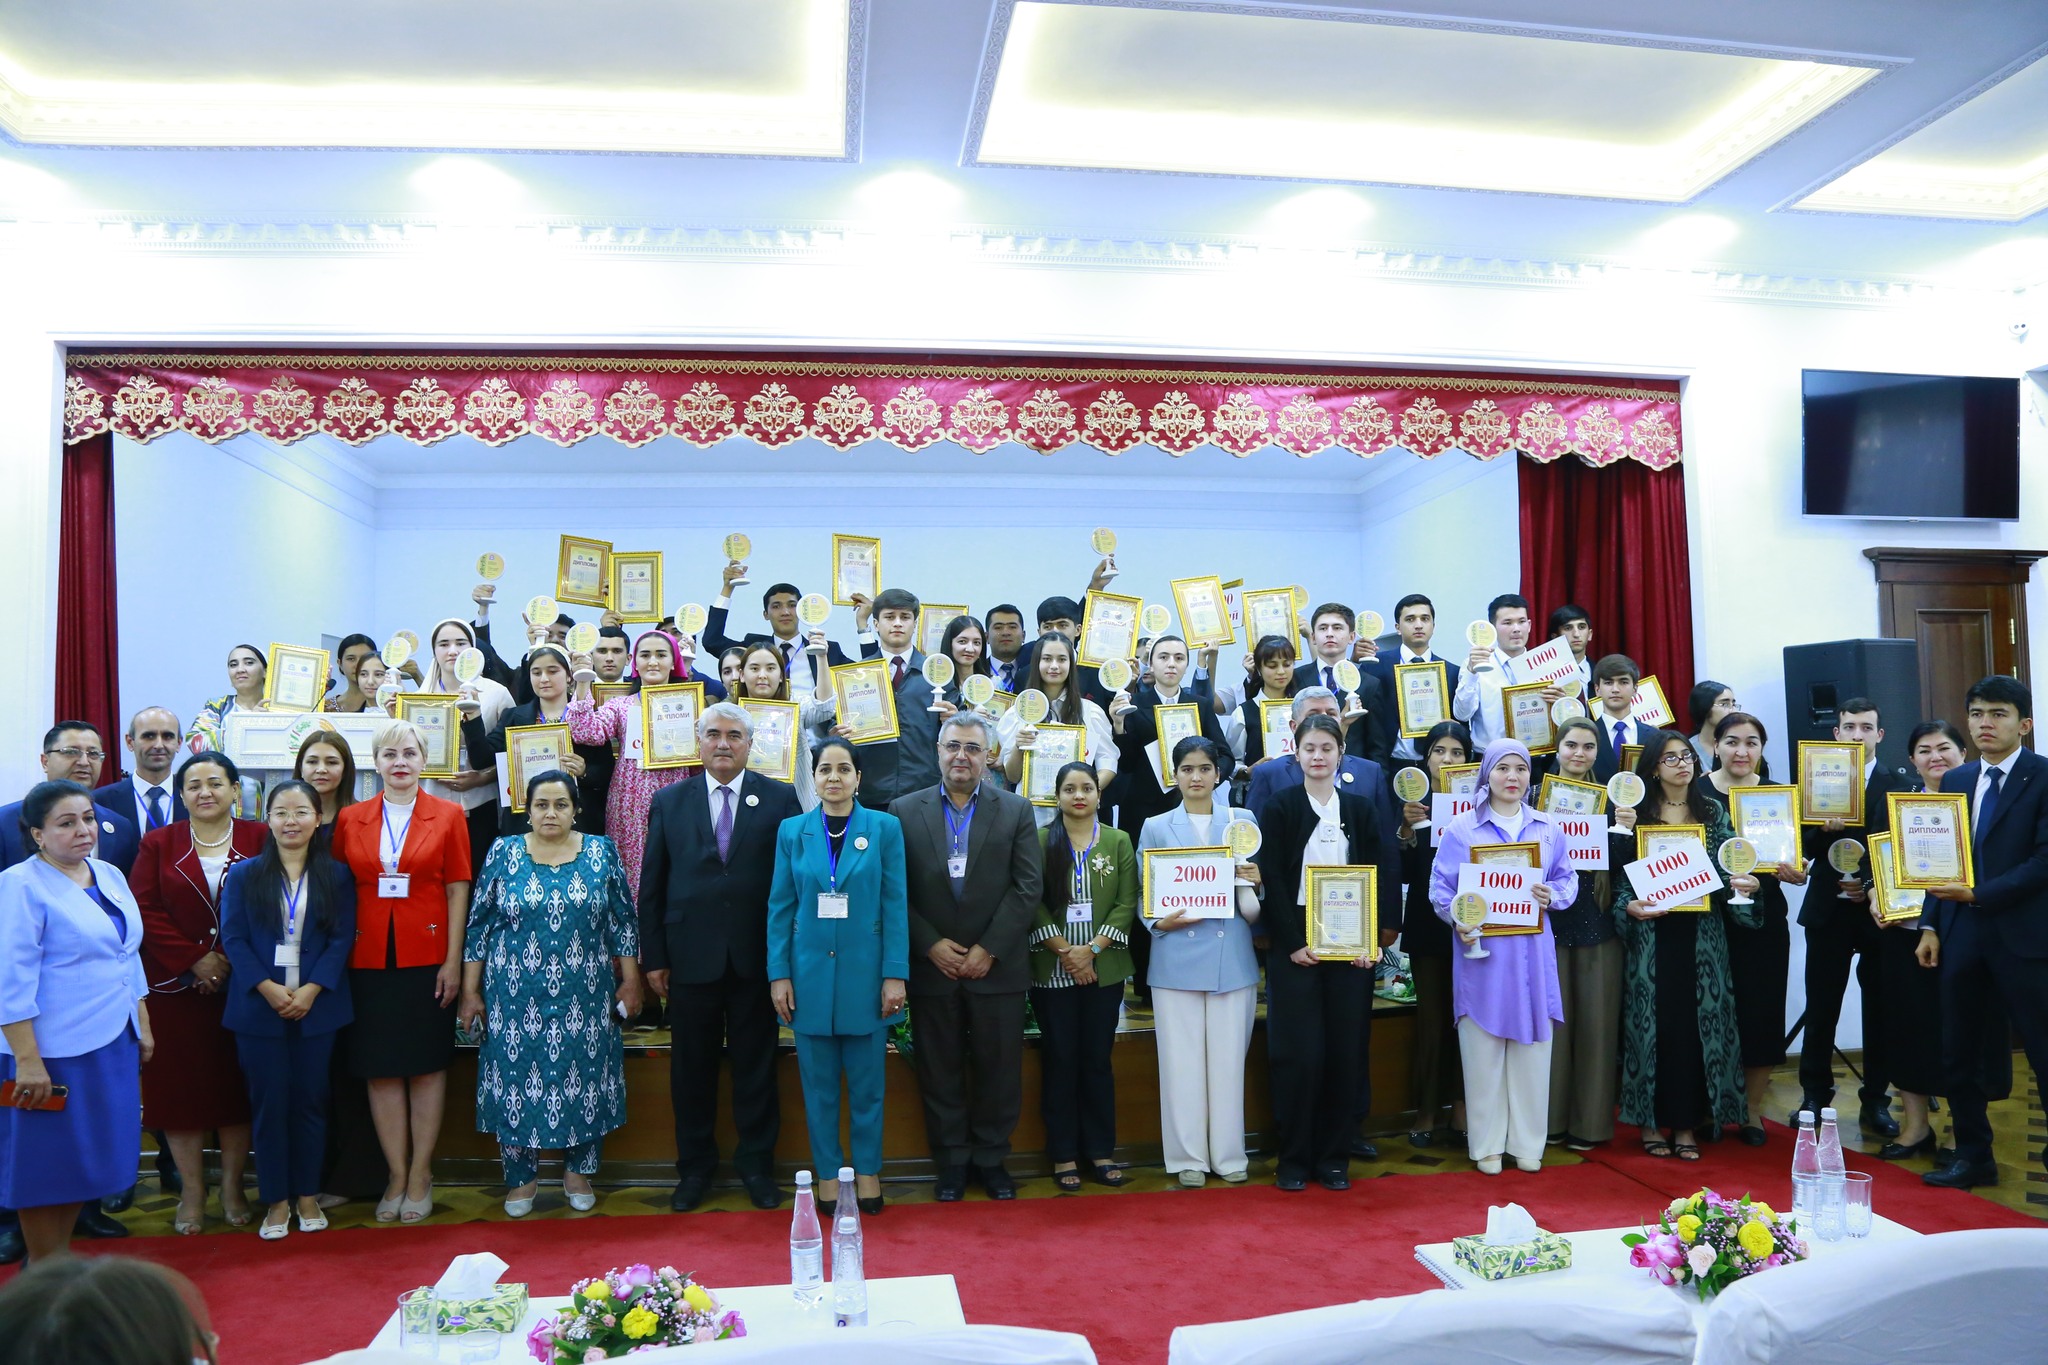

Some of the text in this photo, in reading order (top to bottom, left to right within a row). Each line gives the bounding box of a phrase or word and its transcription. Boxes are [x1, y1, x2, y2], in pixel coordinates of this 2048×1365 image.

[1526, 647, 1557, 670] 1000
[849, 689, 876, 698] ДИПЛОМИ
[1516, 708, 1544, 716] ДИПЛОМИ
[525, 754, 555, 762] ДИПЛОМИ
[1647, 851, 1689, 879] 1000
[1173, 865, 1216, 883] 2000
[1479, 871, 1523, 890] 1000
[1489, 900, 1531, 915] монӣ
